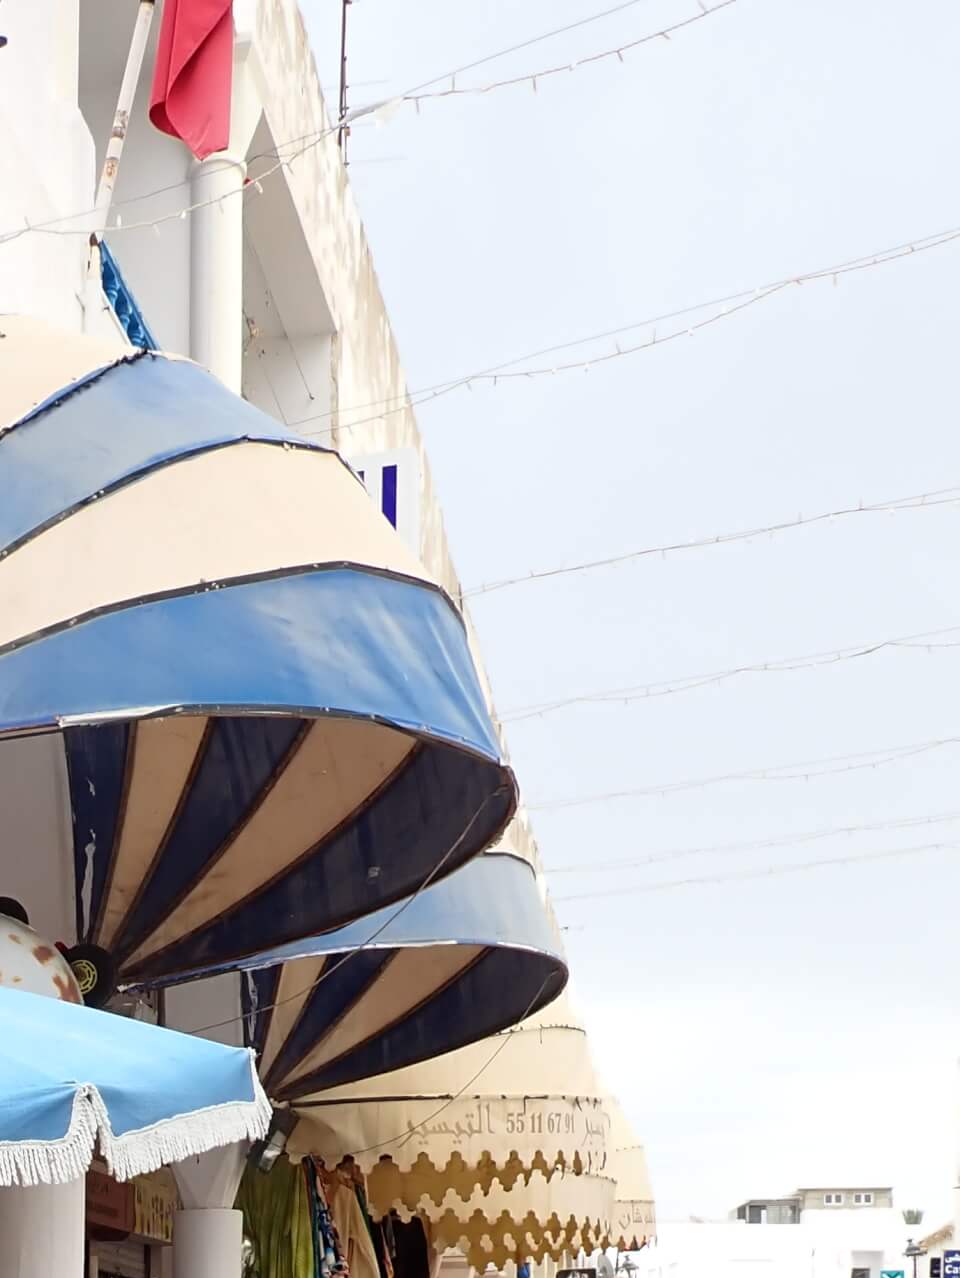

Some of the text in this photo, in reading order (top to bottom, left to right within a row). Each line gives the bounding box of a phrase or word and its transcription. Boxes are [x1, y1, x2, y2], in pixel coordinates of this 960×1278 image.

[506, 1112, 525, 1134] 55
[530, 1112, 543, 1134] 11
[547, 1112, 562, 1134] 67
